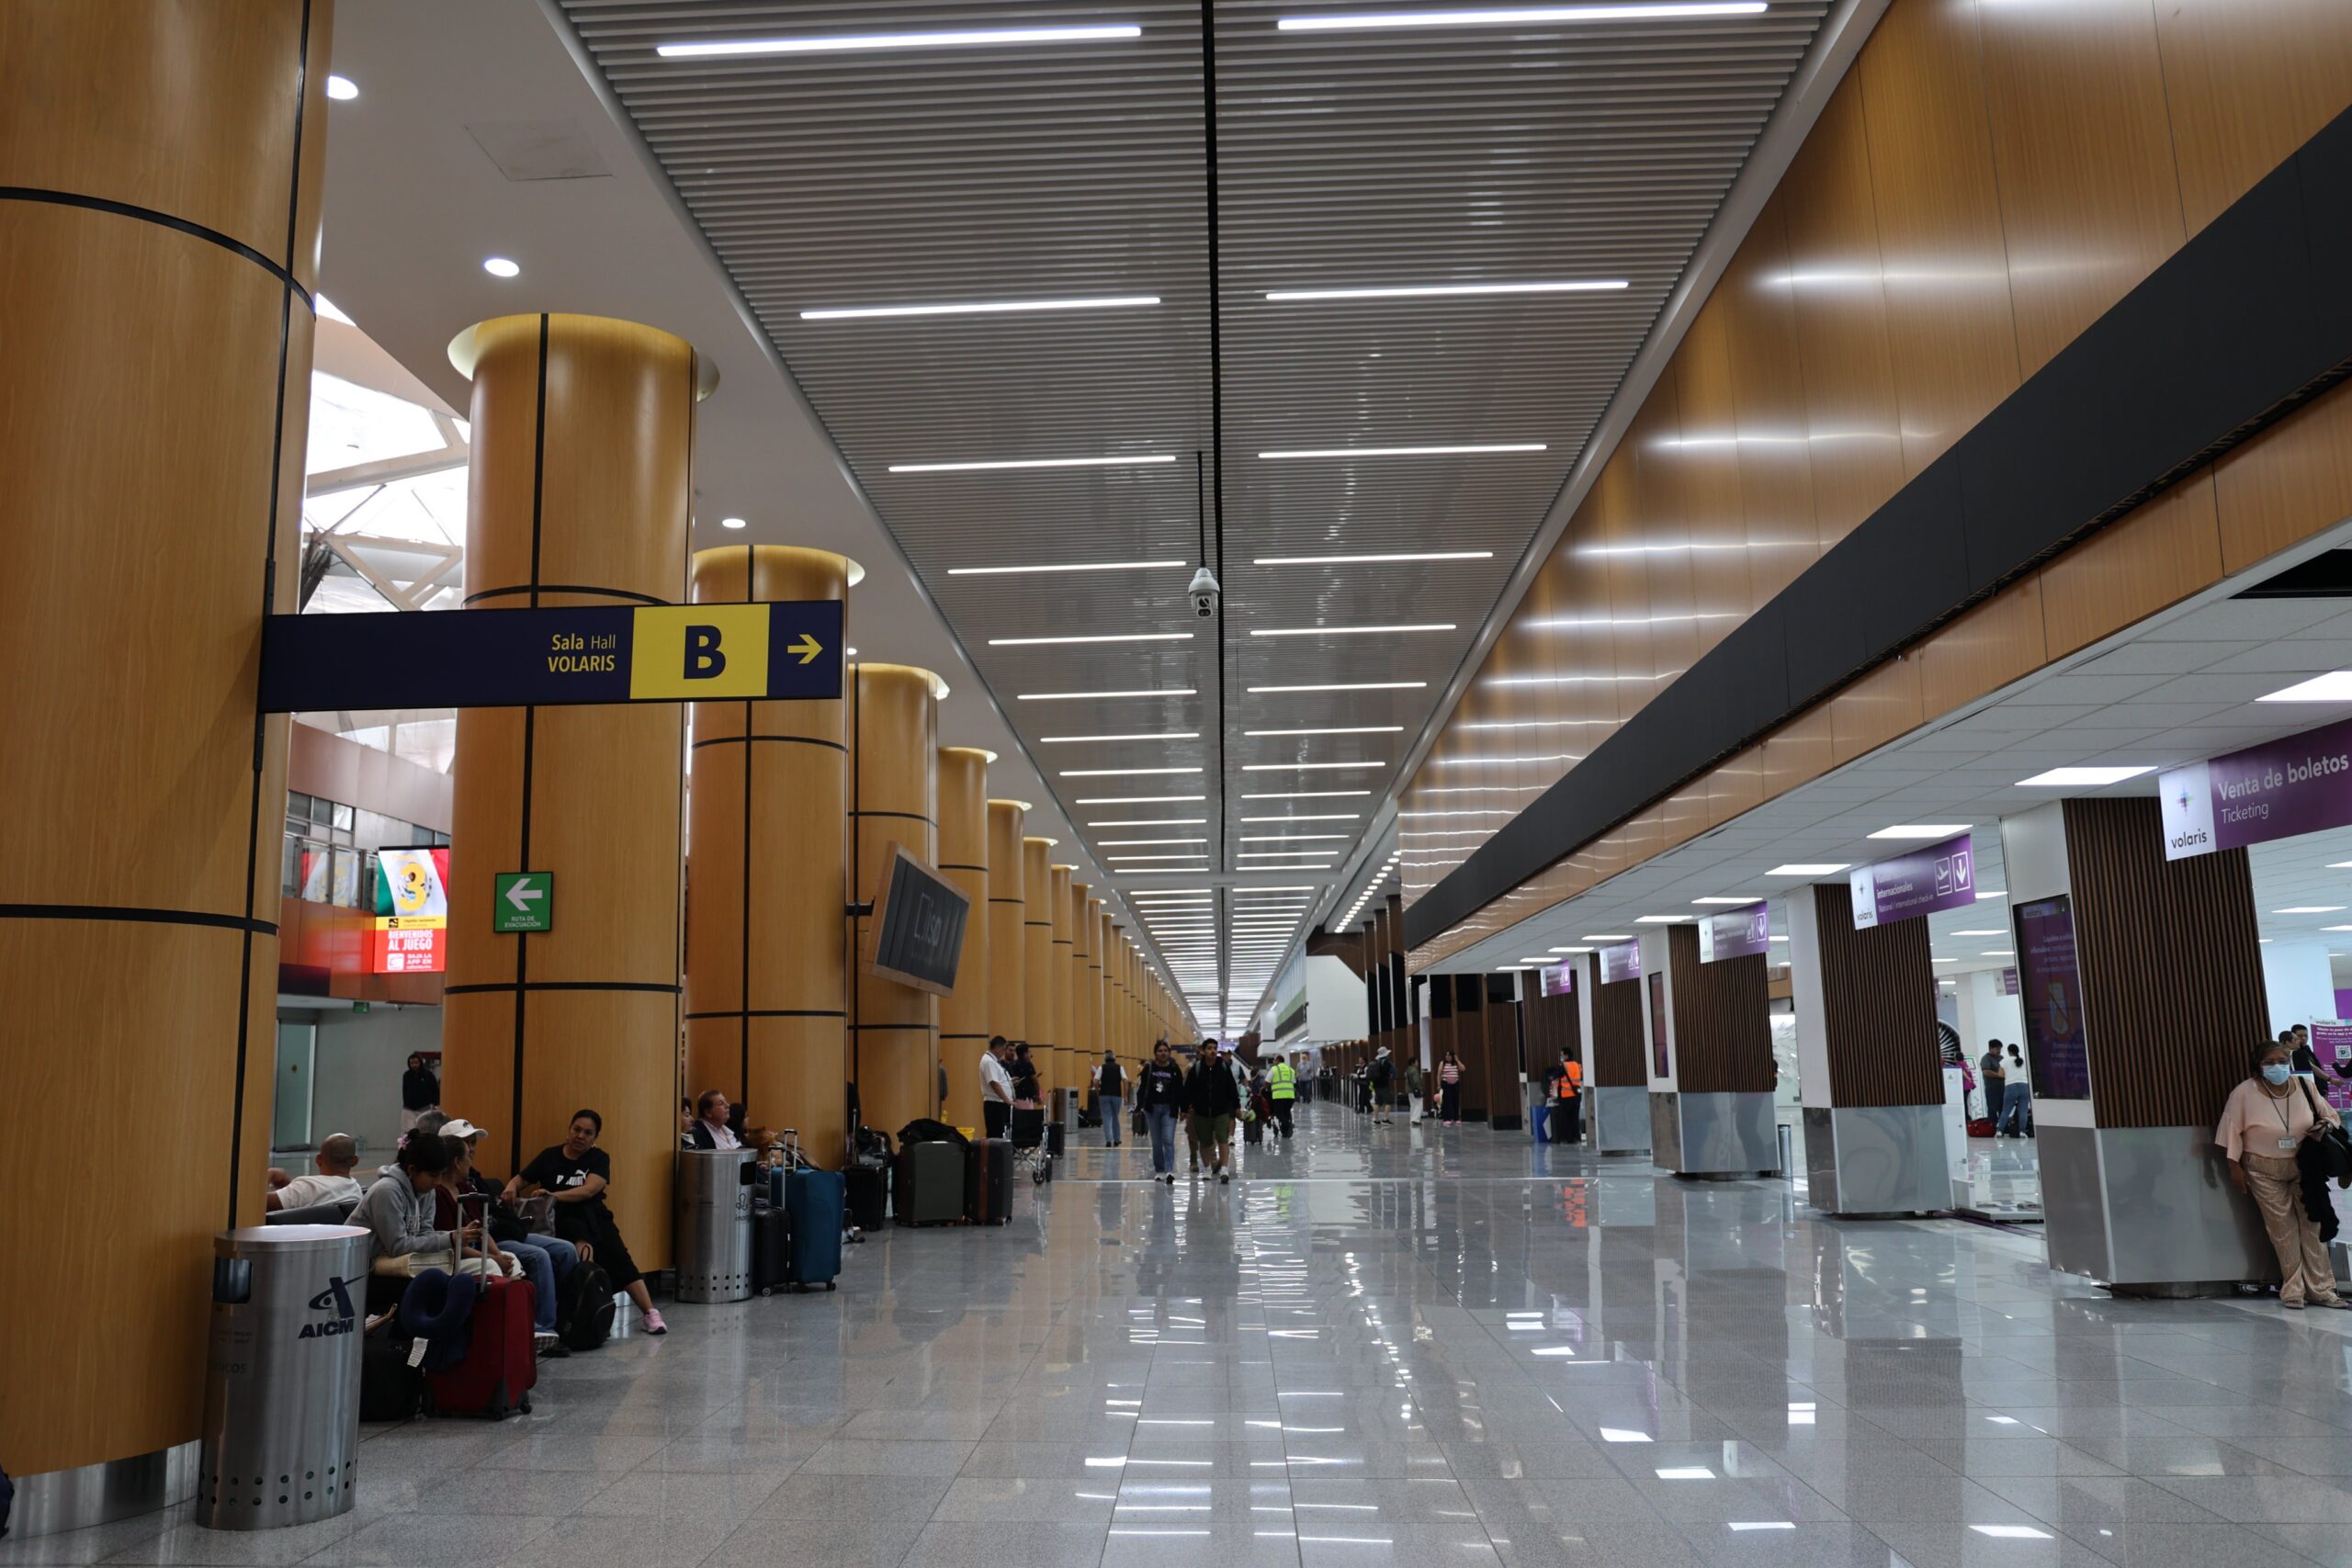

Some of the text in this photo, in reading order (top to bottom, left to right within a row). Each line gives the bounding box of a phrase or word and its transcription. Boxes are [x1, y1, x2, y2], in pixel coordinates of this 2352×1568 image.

[551, 633, 616, 650] Sala Hall
[683, 625, 727, 680] B
[548, 655, 616, 672] VOLARIS
[2218, 753, 2349, 801] Venta de boletos
[2221, 802, 2269, 824] Ticketing
[2171, 829, 2208, 850] volaris
[397, 862, 427, 912] 3
[1877, 882, 1914, 899] internacionales
[1857, 908, 1873, 921] volaris
[388, 930, 434, 940] BIENVENIDOS
[388, 938, 433, 951] AL JUEGO
[298, 1318, 355, 1339] AICM
